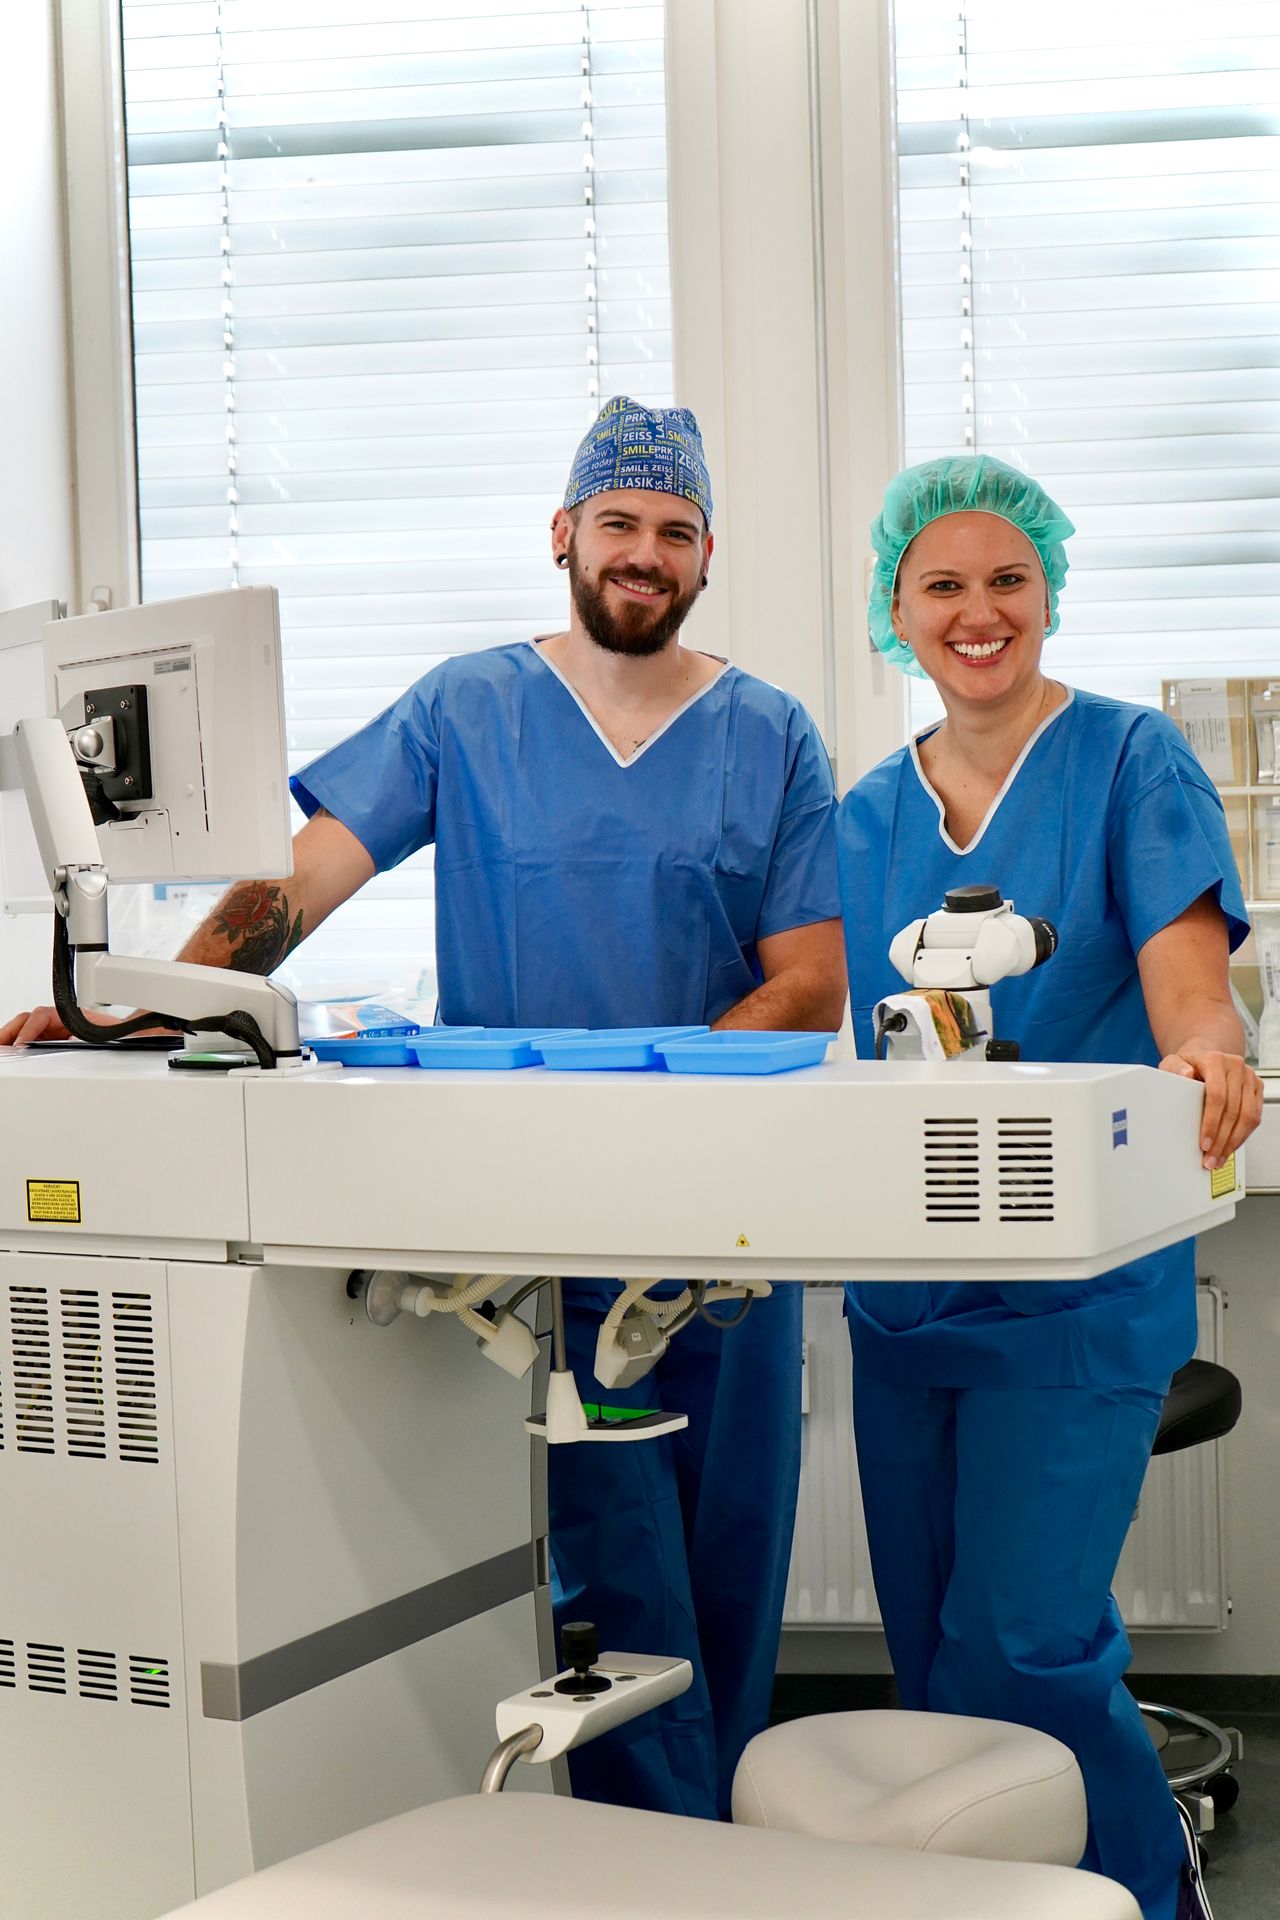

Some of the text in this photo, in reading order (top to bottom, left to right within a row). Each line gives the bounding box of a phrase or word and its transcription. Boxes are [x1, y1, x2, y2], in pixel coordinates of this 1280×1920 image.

[625, 412, 647, 423] PRK
[622, 431, 652, 443] ZEISS
[623, 446, 674, 456] SMILE PRK
[654, 453, 674, 462] SMILE
[620, 464, 673, 474] SMILE ZEISS
[619, 477, 654, 488] LASIK
